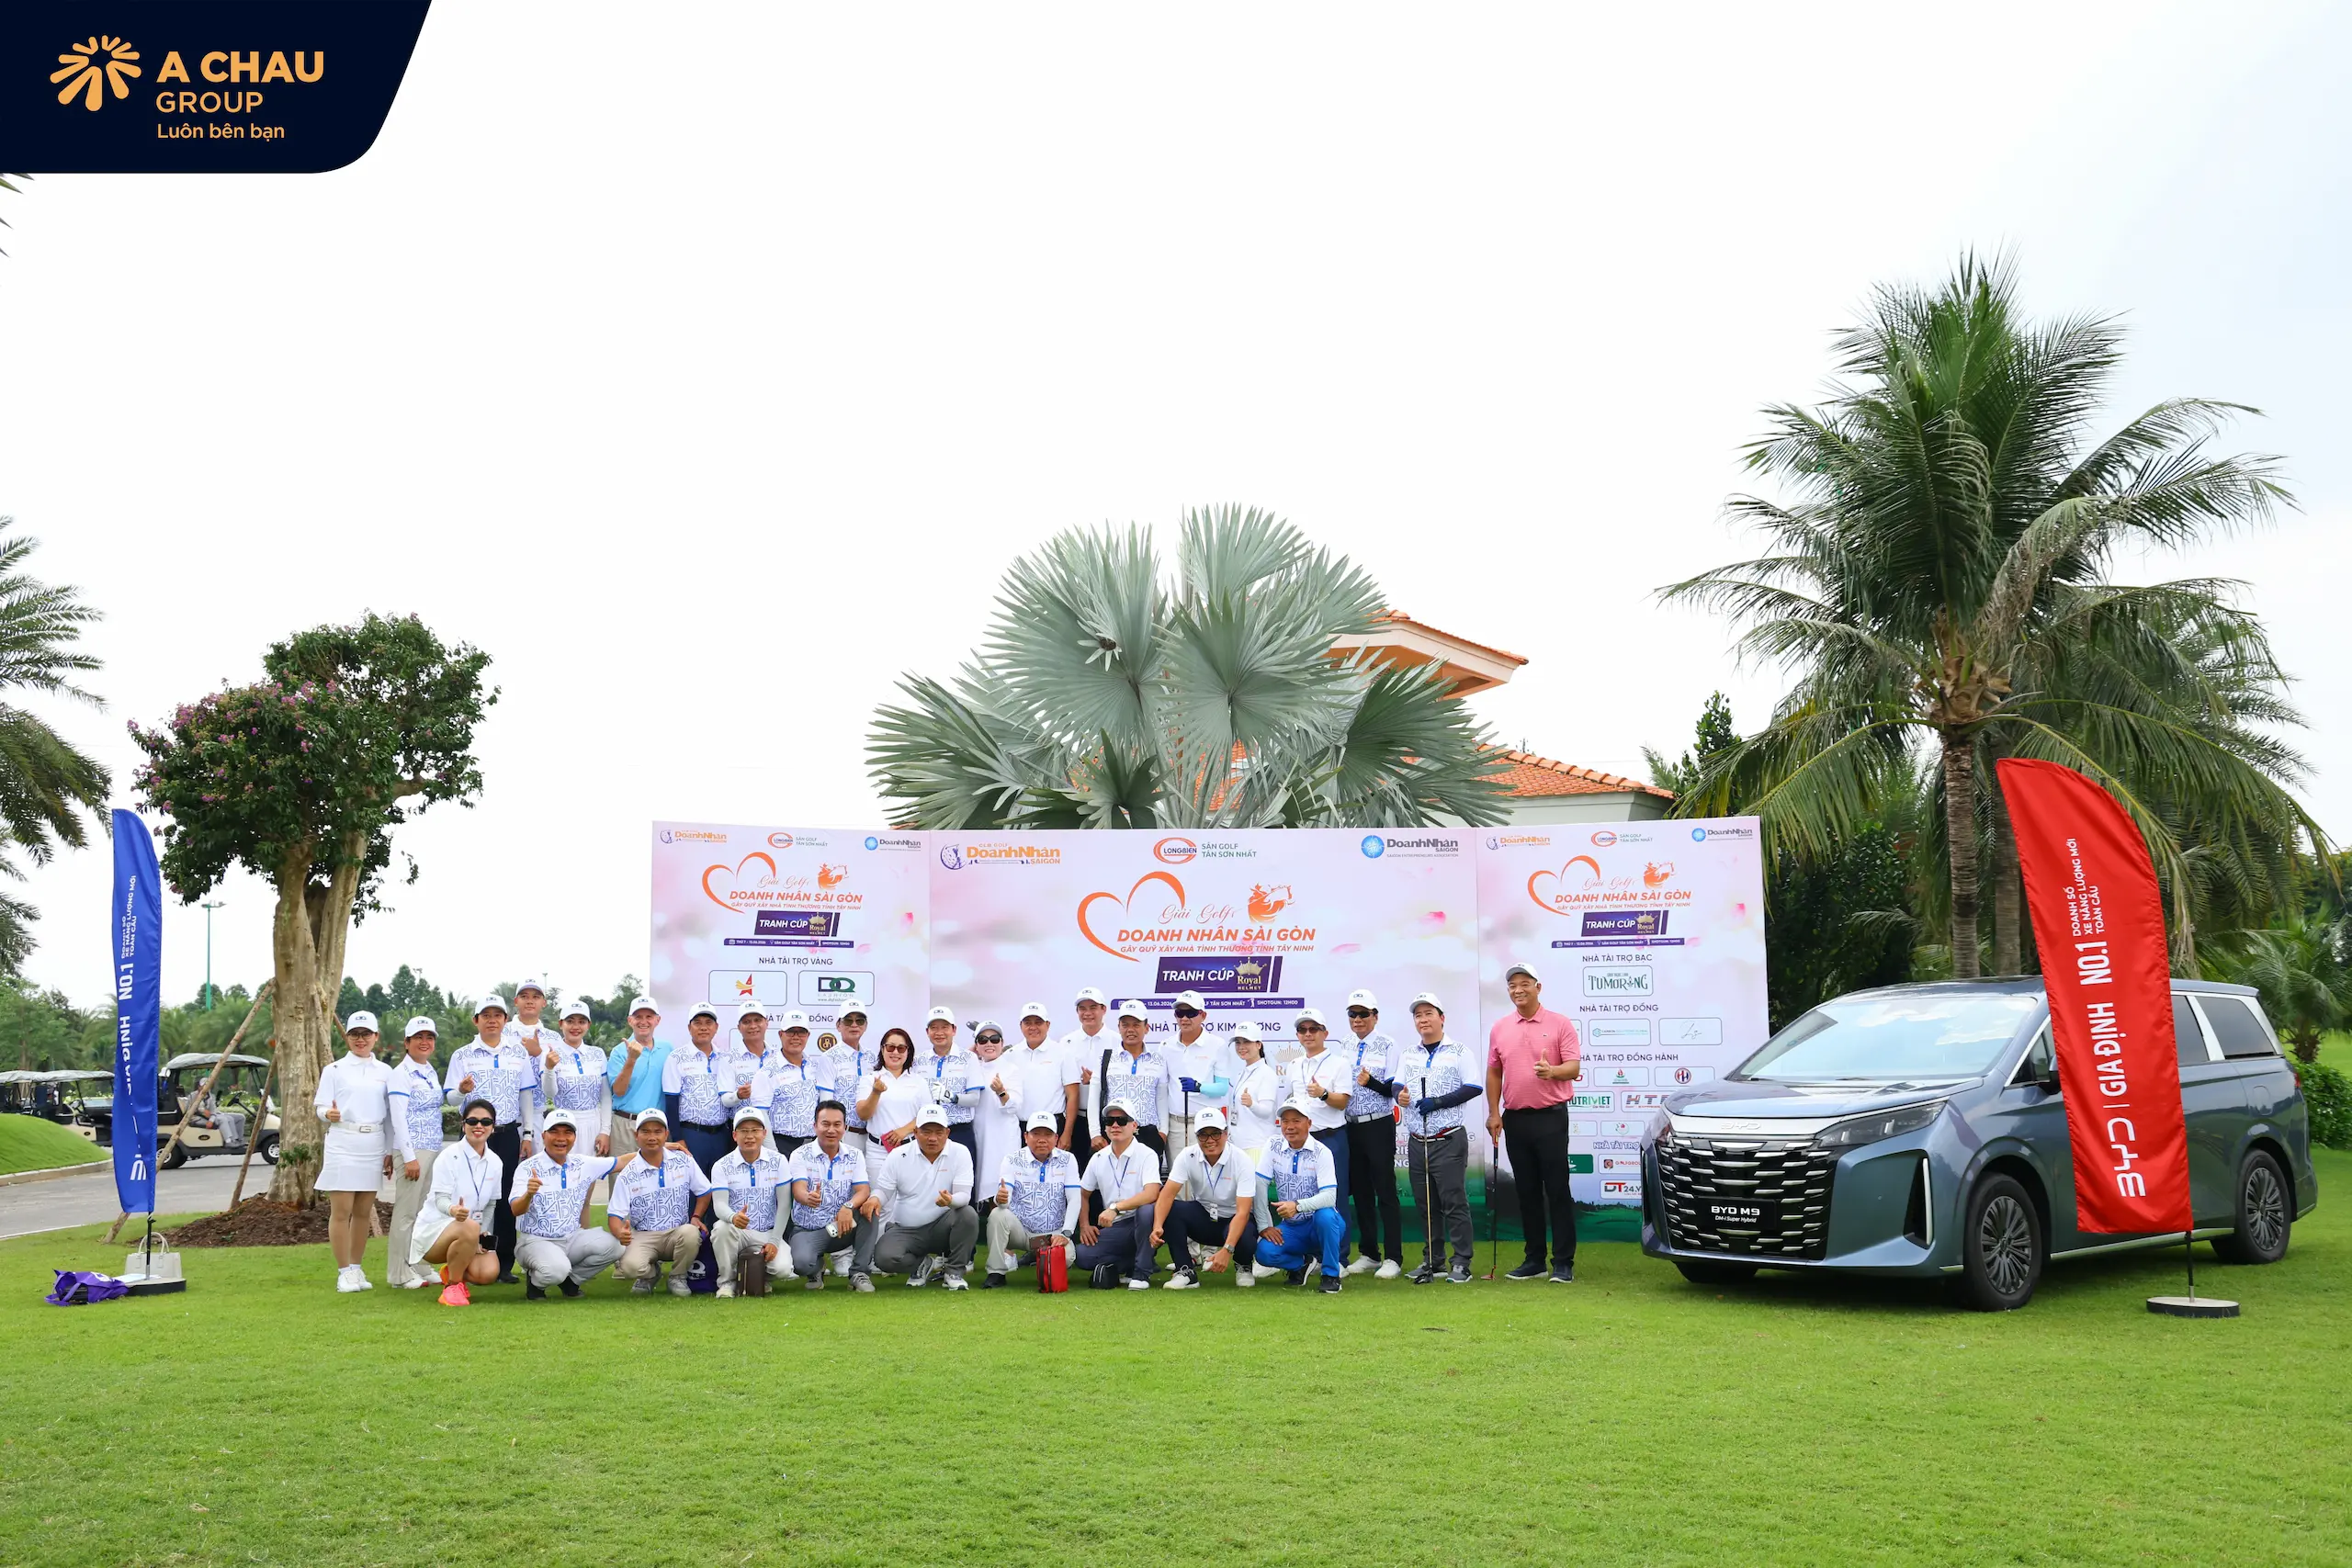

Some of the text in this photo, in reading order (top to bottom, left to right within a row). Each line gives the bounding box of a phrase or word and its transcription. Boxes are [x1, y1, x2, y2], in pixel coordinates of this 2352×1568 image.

[967, 846, 1060, 859] DoanhNhân
[1237, 849, 1257, 858] NHẤT
[2065, 838, 2093, 935] XE NĂNG LƯỢNG MỚI
[729, 891, 864, 904] DOANH NHÂN SÀI GÒN
[1555, 889, 1691, 904] DOANH NHÂN SÀI GÒN
[1159, 904, 1235, 925] Giải Golf
[2063, 886, 2082, 937] DOANH SỐ
[2087, 886, 2104, 934] TOÀN CẦU
[759, 919, 808, 928] TRANH CÚP
[1586, 919, 1635, 930] TRANH CÚP
[1117, 925, 1316, 942] DOANH NHÂN SÀI GÒN
[1120, 944, 1137, 953] GÂY
[1139, 944, 1156, 953] QUỸ
[1158, 944, 1175, 953] XÂY
[1176, 944, 1194, 953] NHÀ
[1197, 944, 1216, 953] TÌNH
[1218, 944, 1254, 953] THƯƠNG
[759, 956, 776, 964] NHÀ
[792, 957, 808, 966] TRỢ
[810, 957, 833, 965] VÀNG
[1582, 953, 1653, 963] NHÀ TÀI TRỢ BẠC
[1161, 967, 1235, 981] TRANH CÚP
[118, 963, 134, 1001] NO.1
[818, 976, 856, 993] DQ
[1237, 976, 1261, 987] Royal
[1580, 1002, 1659, 1014] NHÀ TÀI TRỢ ĐỒNG
[808, 1012, 834, 1021] ĐỒNG
[1148, 1021, 1170, 1032] NHÀ
[1217, 1022, 1237, 1032] KIM
[1593, 1054, 1606, 1062] TÀI
[1608, 1054, 1624, 1063] TRỢ
[1626, 1053, 1653, 1062] ĐỒNG
[1656, 1053, 1678, 1061] HÀNH
[2075, 941, 2146, 1198] BYD GIA ĐỊNH NO.1
[1593, 1141, 1610, 1150] NHÀ
[1610, 1141, 1623, 1150] TÀI
[1711, 1205, 1760, 1216] BYD M9
